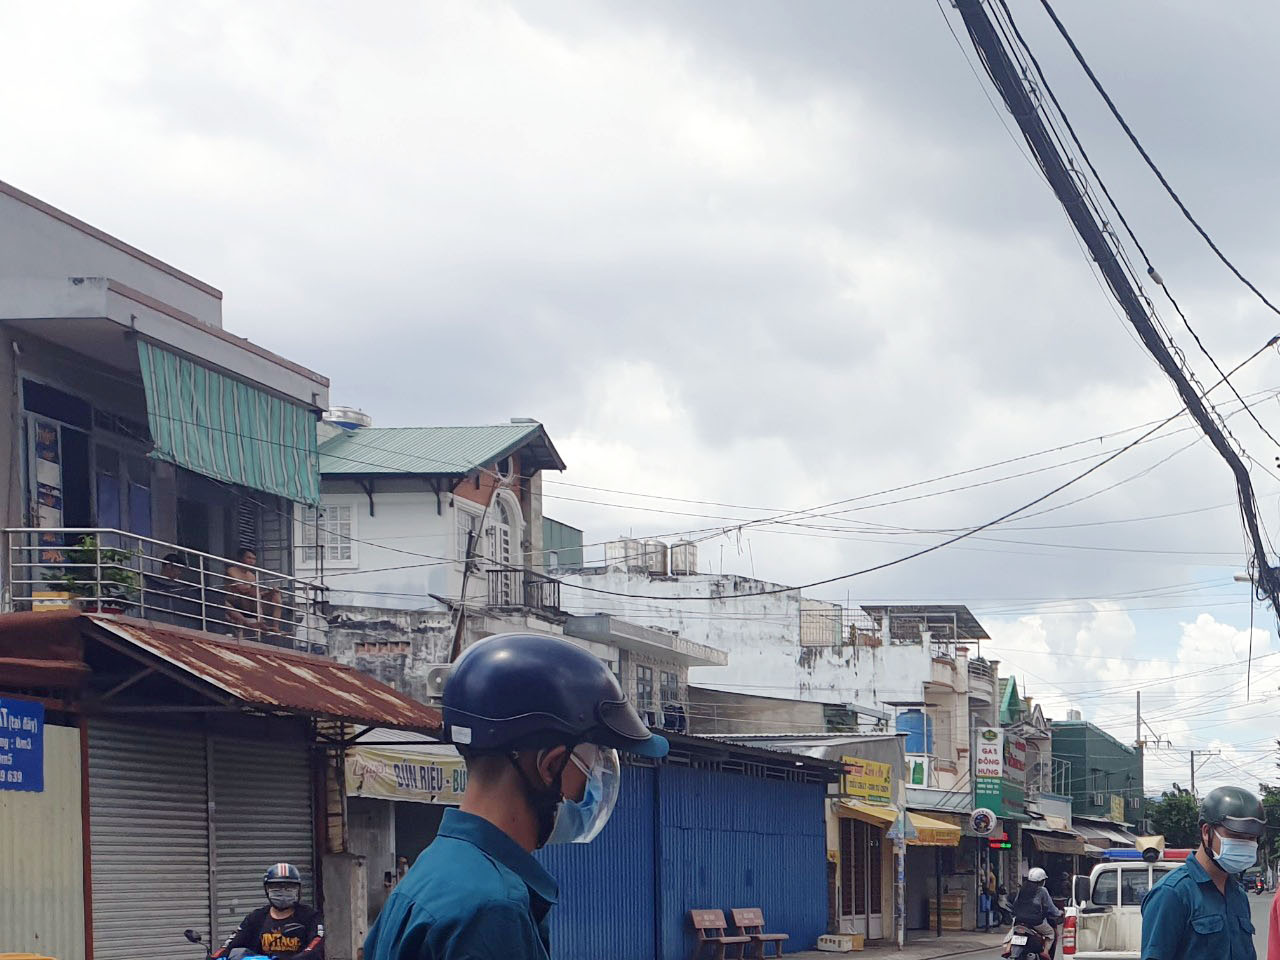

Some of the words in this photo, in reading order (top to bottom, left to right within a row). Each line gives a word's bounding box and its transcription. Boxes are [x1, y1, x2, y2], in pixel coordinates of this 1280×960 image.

[977, 755, 1000, 766] ĐÔNG
[393, 758, 418, 789] BÚN
[452, 764, 469, 793] BÚ
